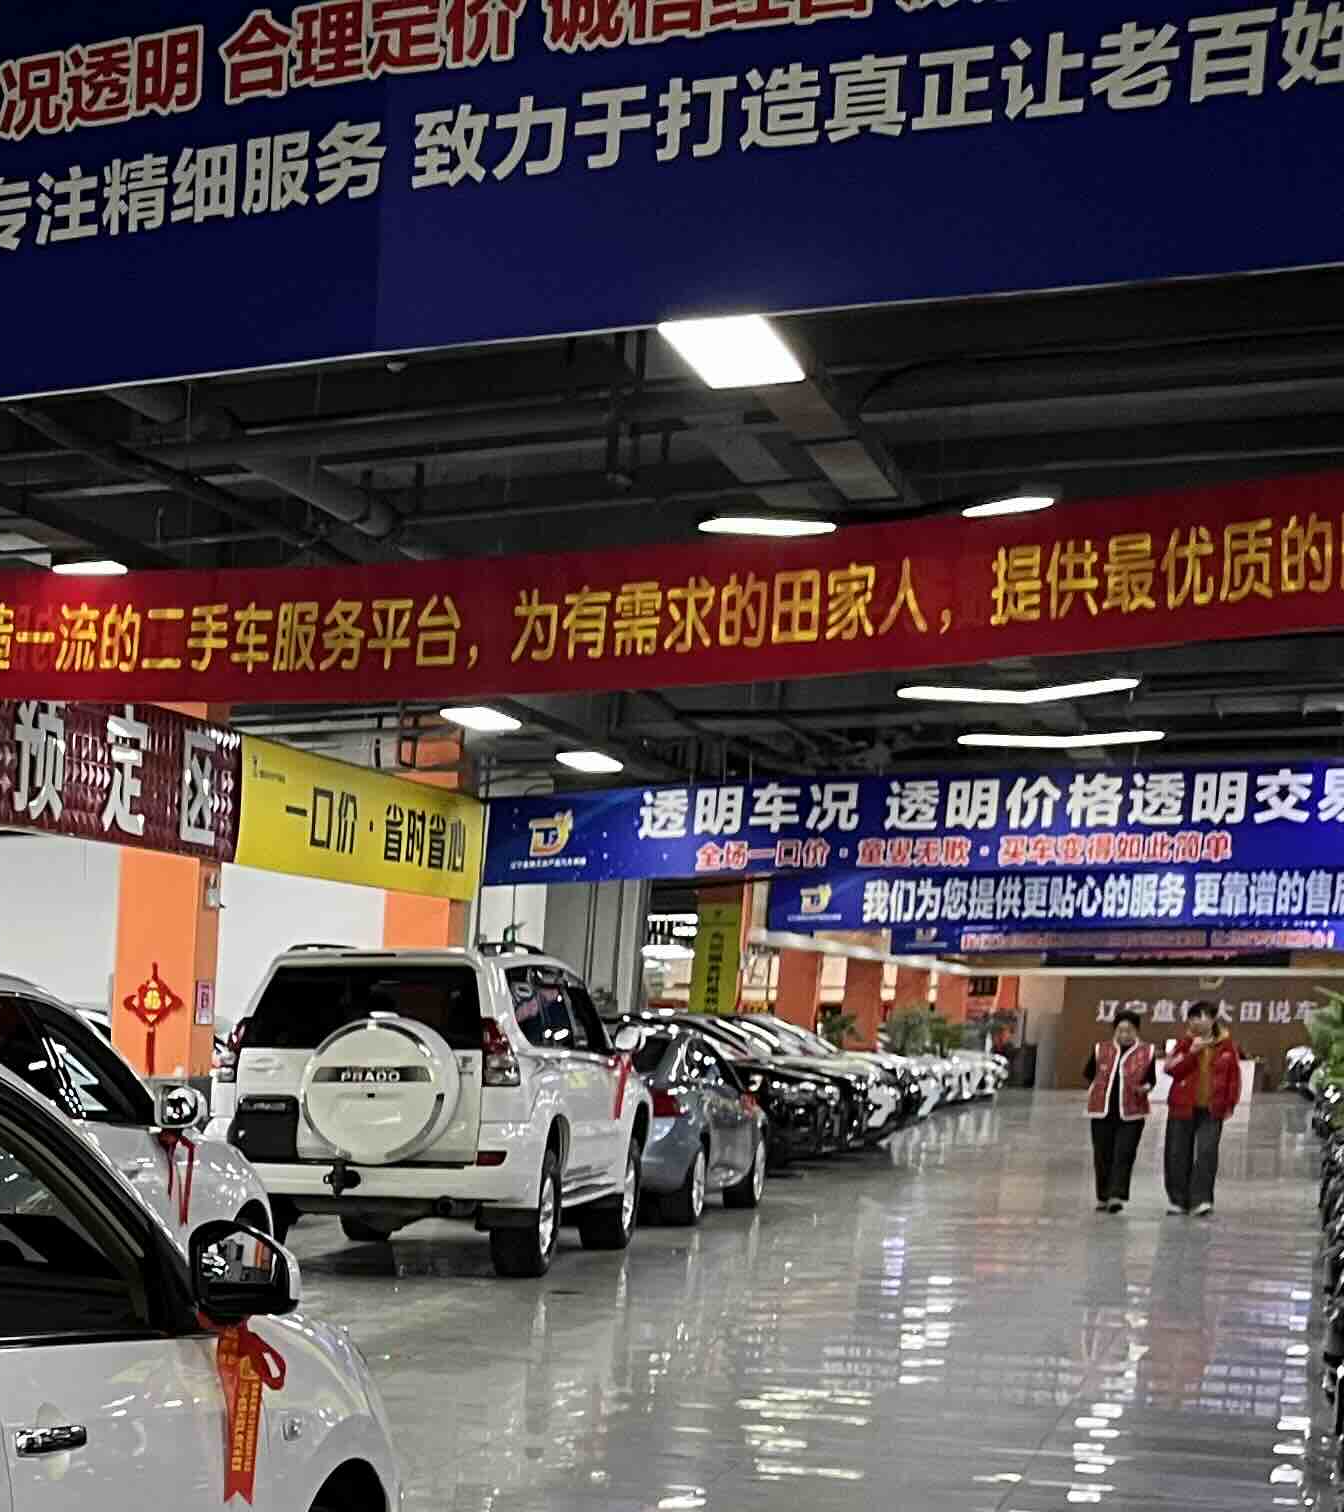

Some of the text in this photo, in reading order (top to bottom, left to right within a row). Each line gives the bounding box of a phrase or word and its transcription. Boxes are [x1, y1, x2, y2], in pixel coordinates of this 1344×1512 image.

[219, 0, 518, 102] 合理定价
[638, 782, 861, 840] 透明车况
[861, 871, 1187, 924] 我们为您提供更贴心的服务
[340, 1069, 401, 1083] PRADO
